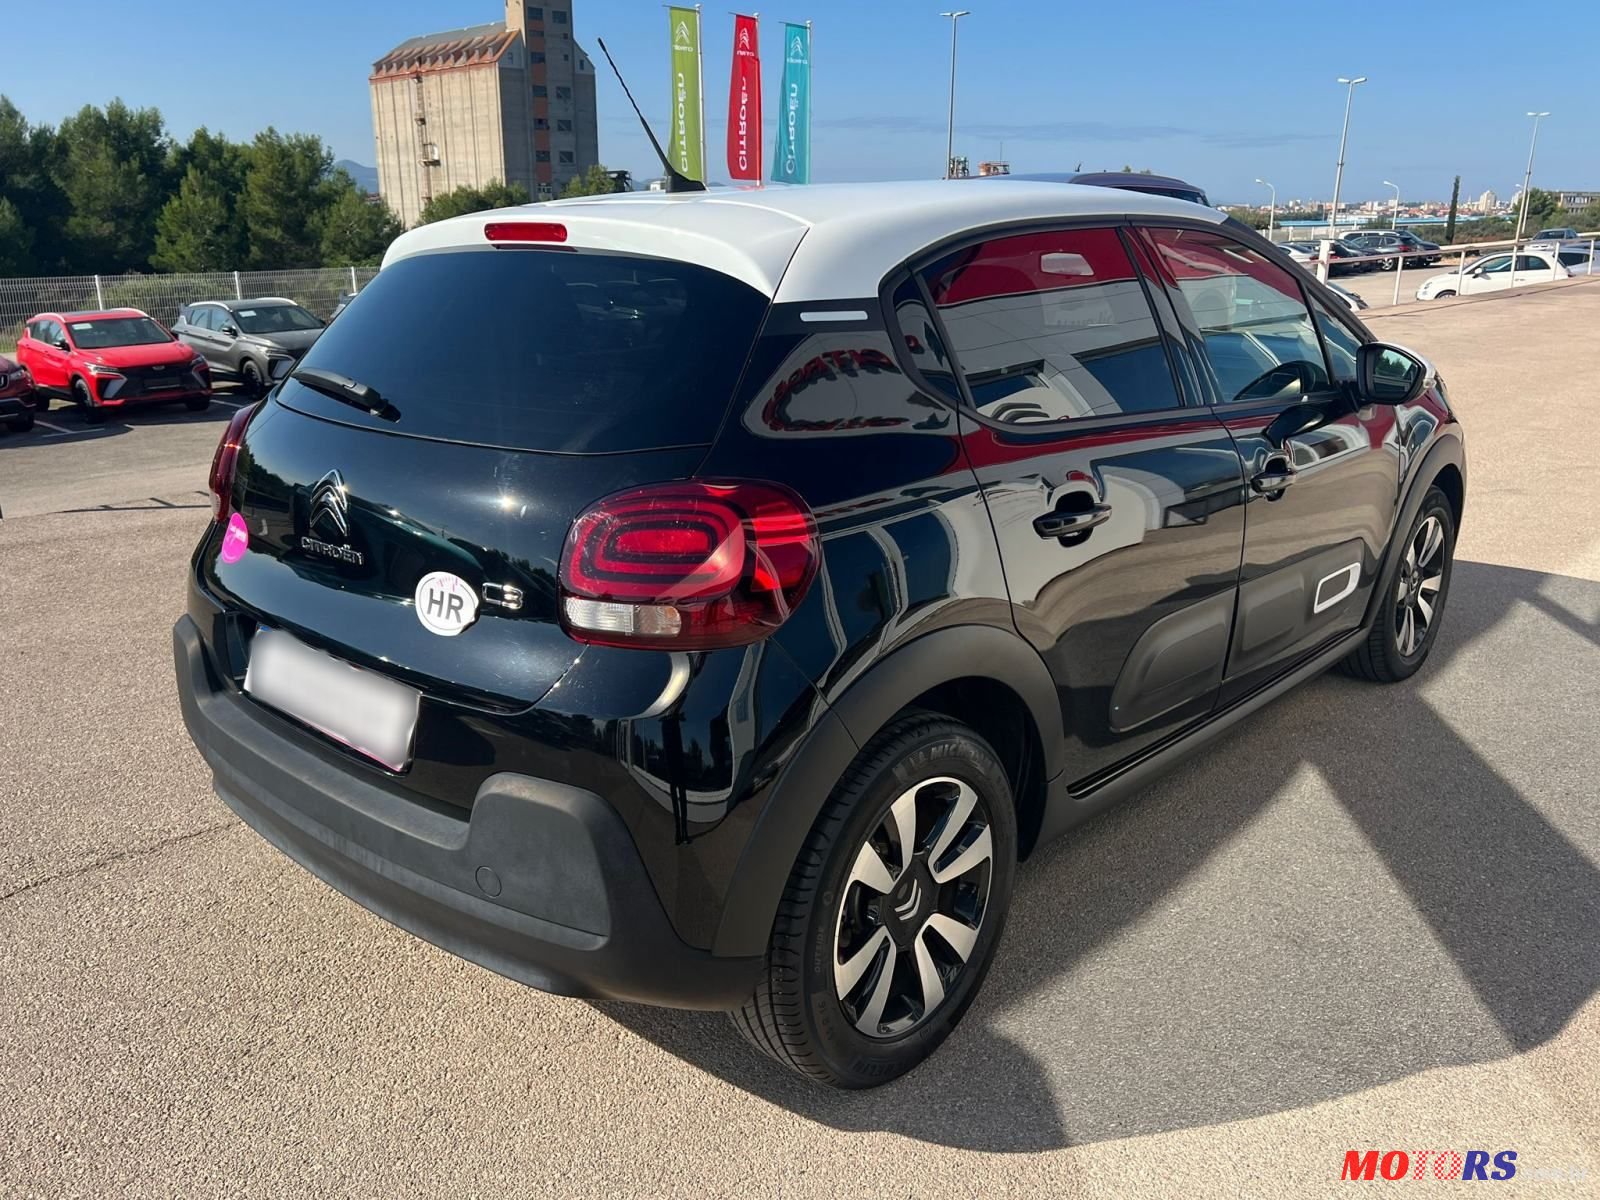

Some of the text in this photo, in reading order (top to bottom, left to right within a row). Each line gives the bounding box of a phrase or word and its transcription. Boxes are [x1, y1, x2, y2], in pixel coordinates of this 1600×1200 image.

[301, 536, 364, 565] CITROËN
[426, 588, 464, 623] HR
[482, 582, 523, 609] C3
